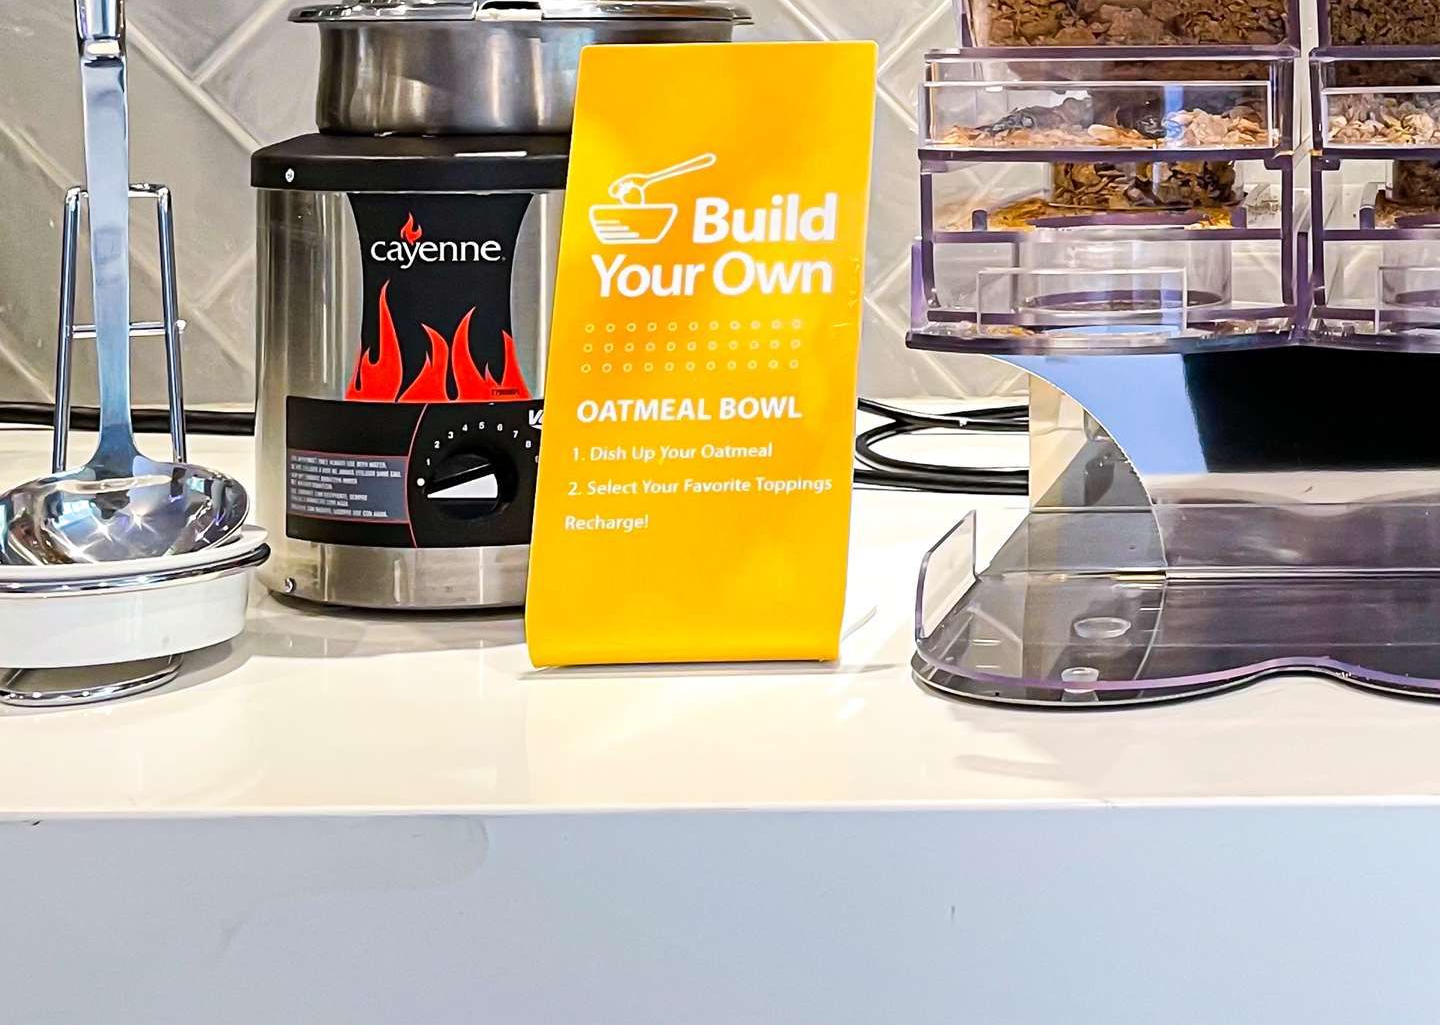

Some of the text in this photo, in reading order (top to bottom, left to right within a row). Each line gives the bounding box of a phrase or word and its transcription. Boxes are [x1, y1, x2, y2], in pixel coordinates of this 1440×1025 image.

[692, 192, 838, 244] Build
[370, 240, 502, 269] cayenne
[591, 251, 833, 298] Your Own
[576, 395, 803, 423] OATMEAL BOWL
[426, 457, 431, 466] 1
[433, 440, 440, 449] 2
[447, 431, 454, 439] 3
[461, 423, 468, 432] 4
[478, 421, 485, 430] 5
[496, 423, 503, 432] 6
[512, 430, 519, 439] 7
[572, 441, 773, 463] 1. Dish Up Your Oatmeal
[567, 476, 833, 496] 2. Select Your Favorite Toppings
[564, 514, 649, 533] Recharge!
